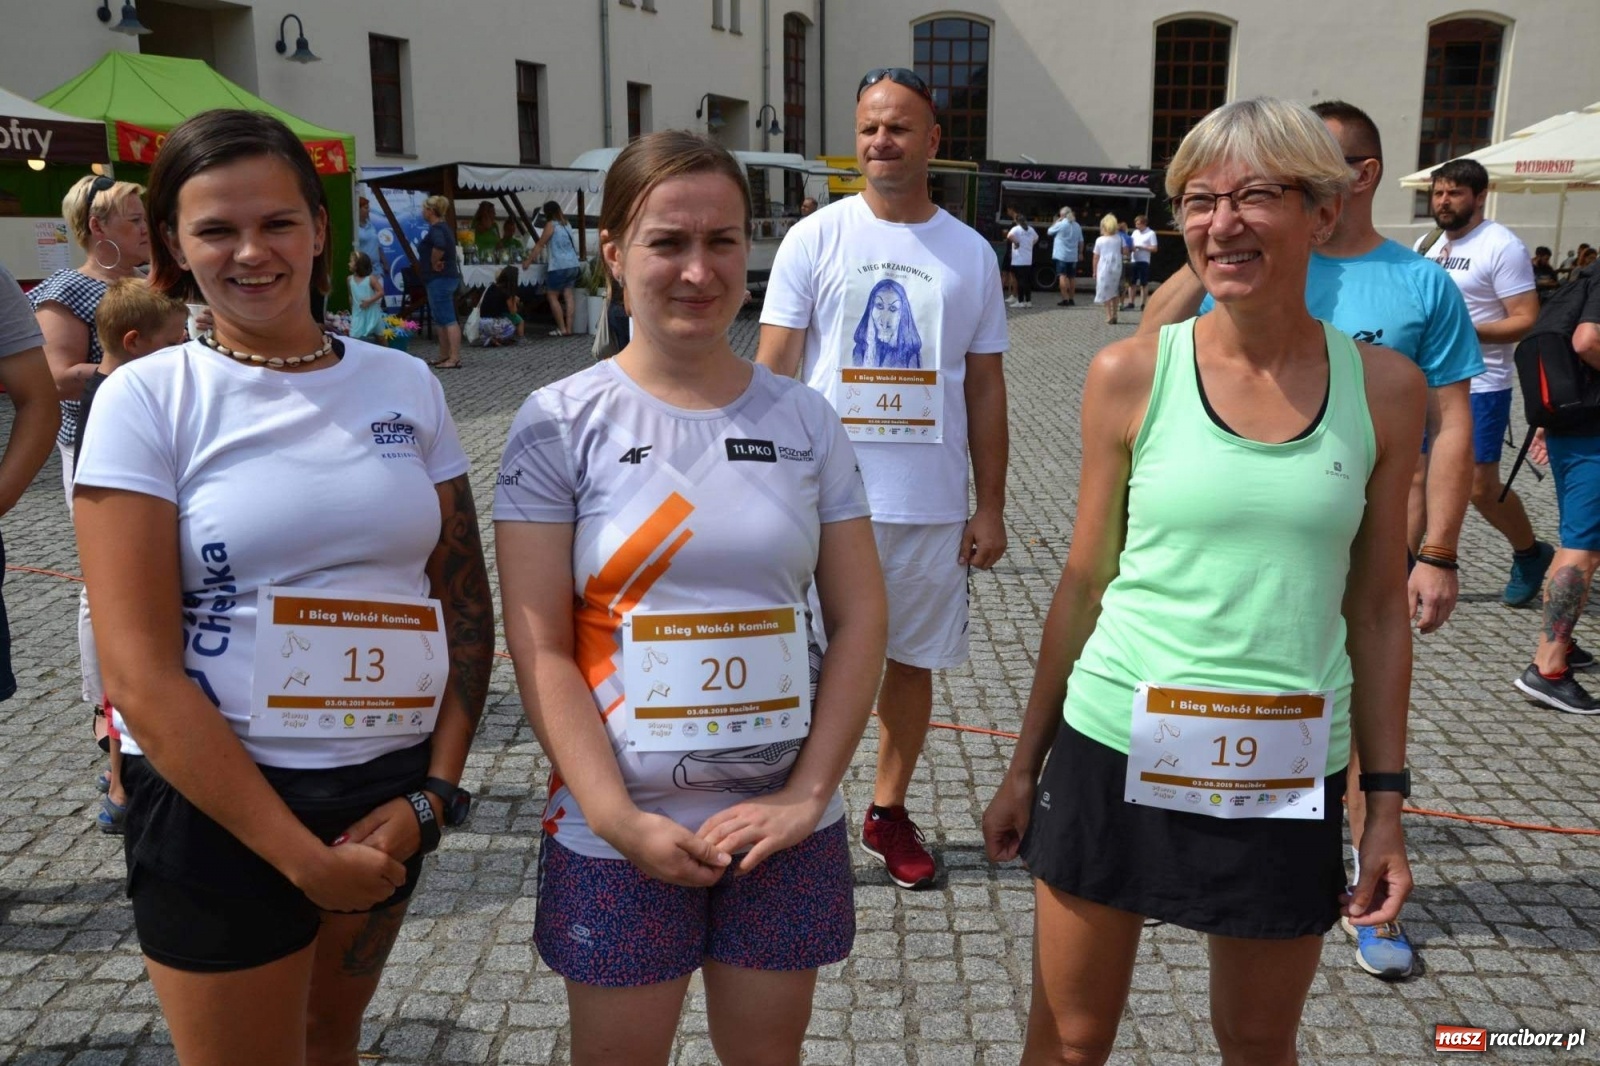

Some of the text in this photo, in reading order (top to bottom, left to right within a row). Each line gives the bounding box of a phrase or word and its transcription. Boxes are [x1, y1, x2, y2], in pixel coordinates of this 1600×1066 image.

[1515, 160, 1575, 173] RACIBORSKIE
[1004, 168, 1150, 184] SLOW BBQ TRUCK
[1444, 257, 1471, 271] HUTA
[862, 263, 880, 272] BIEG
[881, 263, 933, 283] KRZANOWICKI
[876, 393, 902, 412] 44
[619, 445, 652, 464] 4F
[300, 609, 421, 625] I Bieg Wokół Komina
[655, 621, 779, 636] I Bieg Wokół Komina
[343, 647, 385, 682] 13
[701, 656, 747, 691] 20
[687, 707, 728, 716] 03.08.2019
[1171, 700, 1302, 715] I Bieg Wokół Komina
[1211, 736, 1257, 768] 19
[1192, 780, 1233, 788] 03.08.2019
